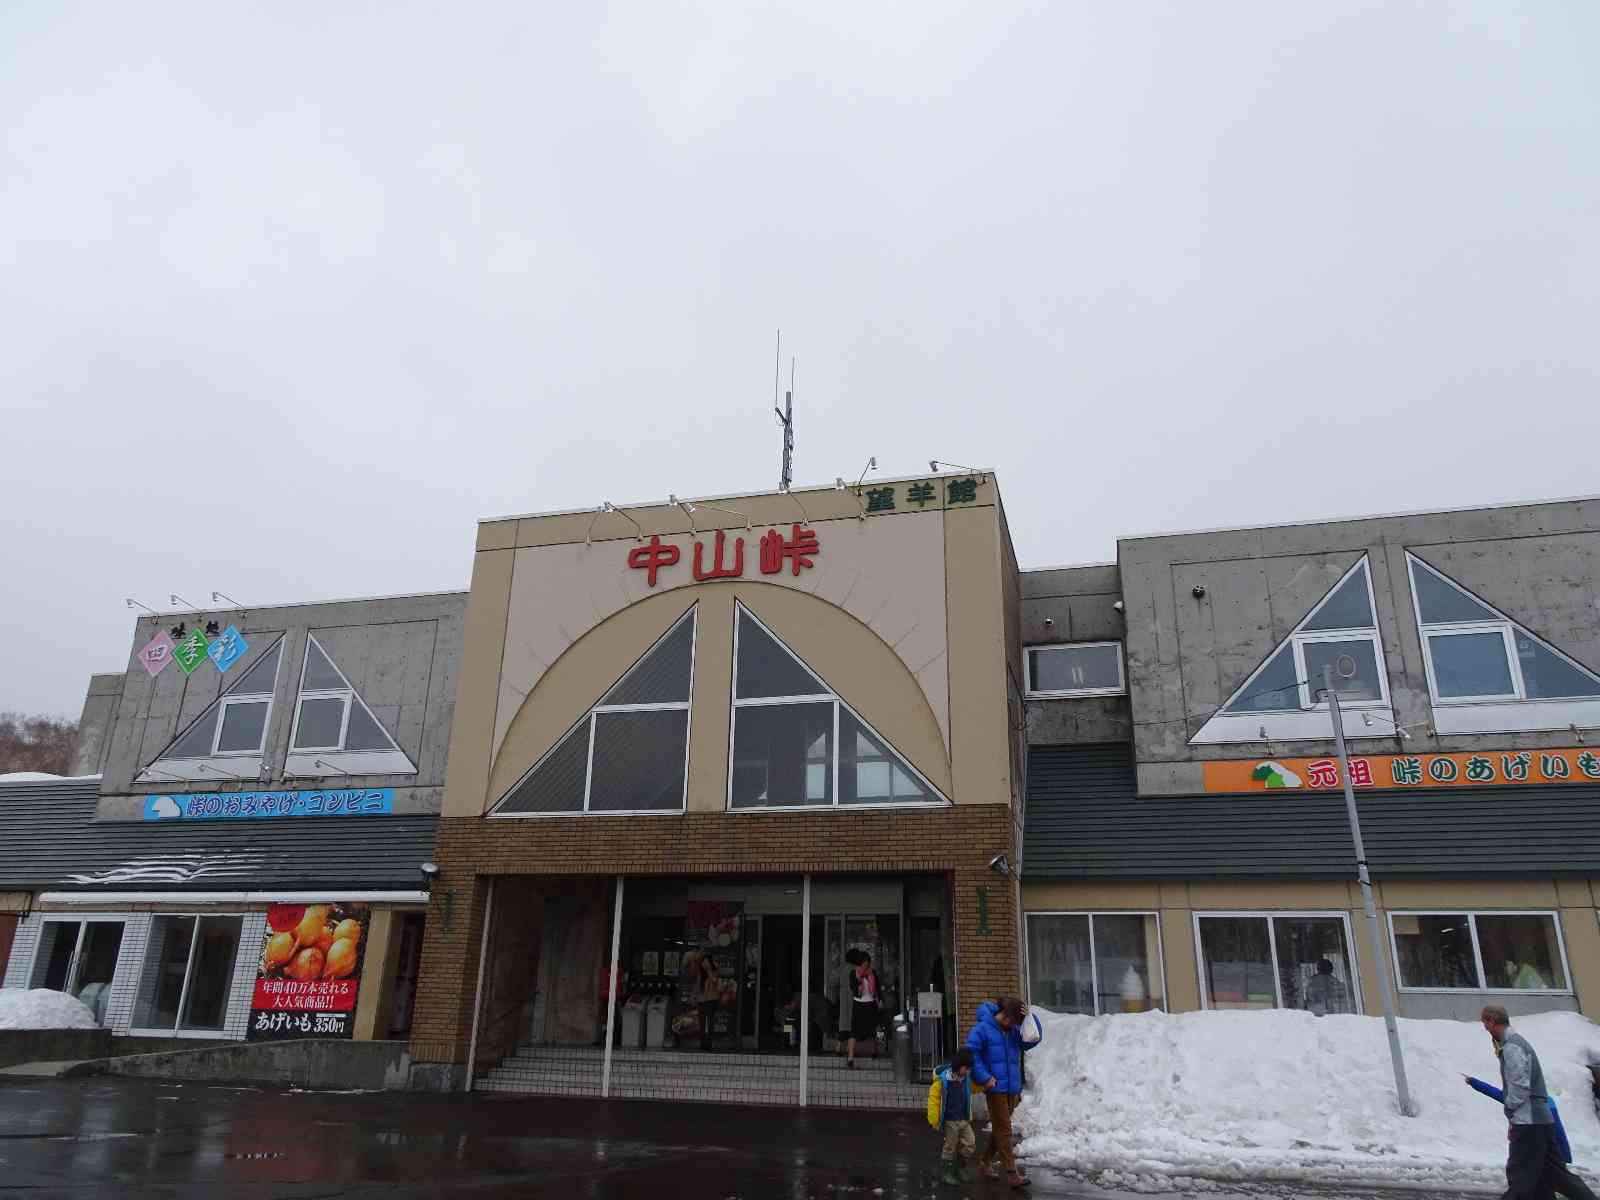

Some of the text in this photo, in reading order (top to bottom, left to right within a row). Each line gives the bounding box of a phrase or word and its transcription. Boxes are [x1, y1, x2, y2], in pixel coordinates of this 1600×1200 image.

[865, 478, 977, 511] 望羊館
[628, 523, 820, 586] 中山峠
[146, 635, 237, 664] 四季彩
[263, 981, 349, 994] 年間40万本売れる
[255, 1012, 344, 1033] あげいも 350円
